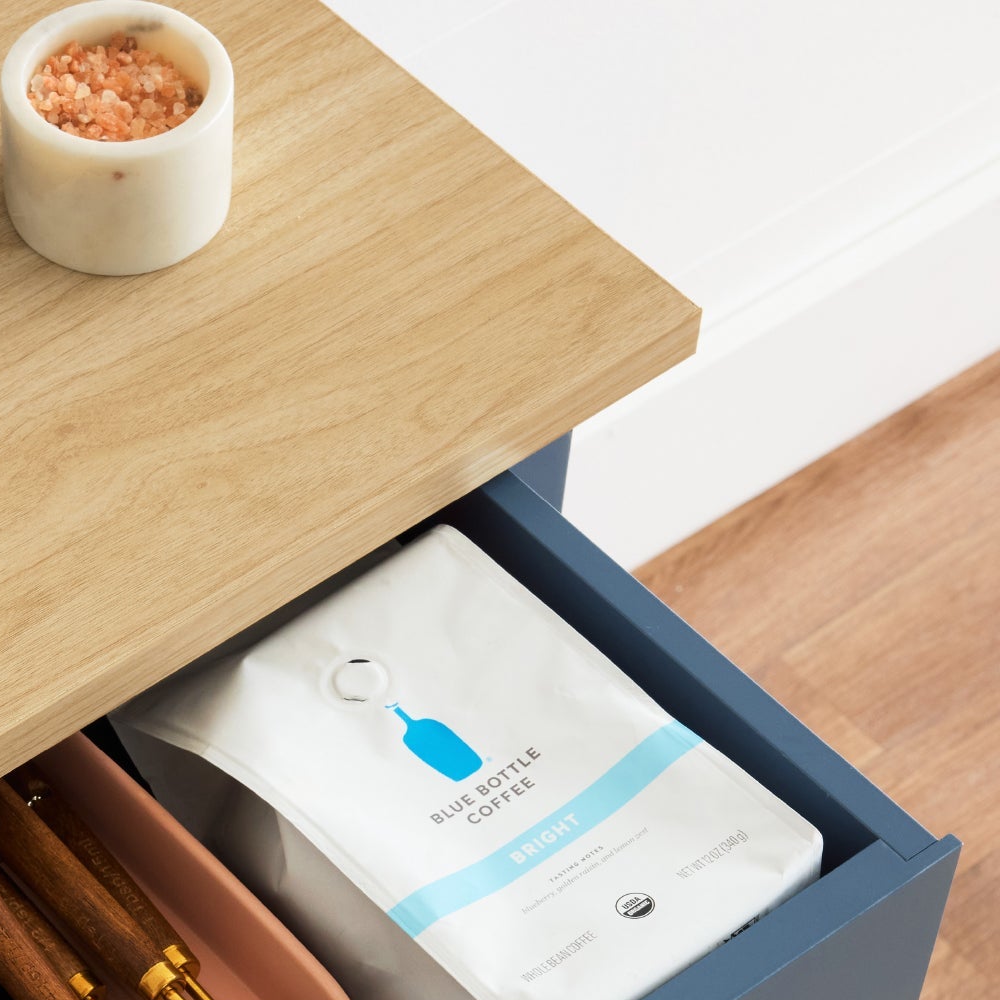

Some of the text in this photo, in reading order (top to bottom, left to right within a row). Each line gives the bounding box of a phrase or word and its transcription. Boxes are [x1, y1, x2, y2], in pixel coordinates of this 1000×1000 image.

[430, 747, 541, 824] BLUE BOTTLE
[467, 776, 535, 824] COFFEE
[509, 812, 580, 864] BRIGHT
[549, 845, 604, 883] TASTING NOTES
[676, 865, 695, 880] NET
[621, 896, 641, 910] USDA
[520, 929, 598, 983] WHOLE BEAN COFFEE
